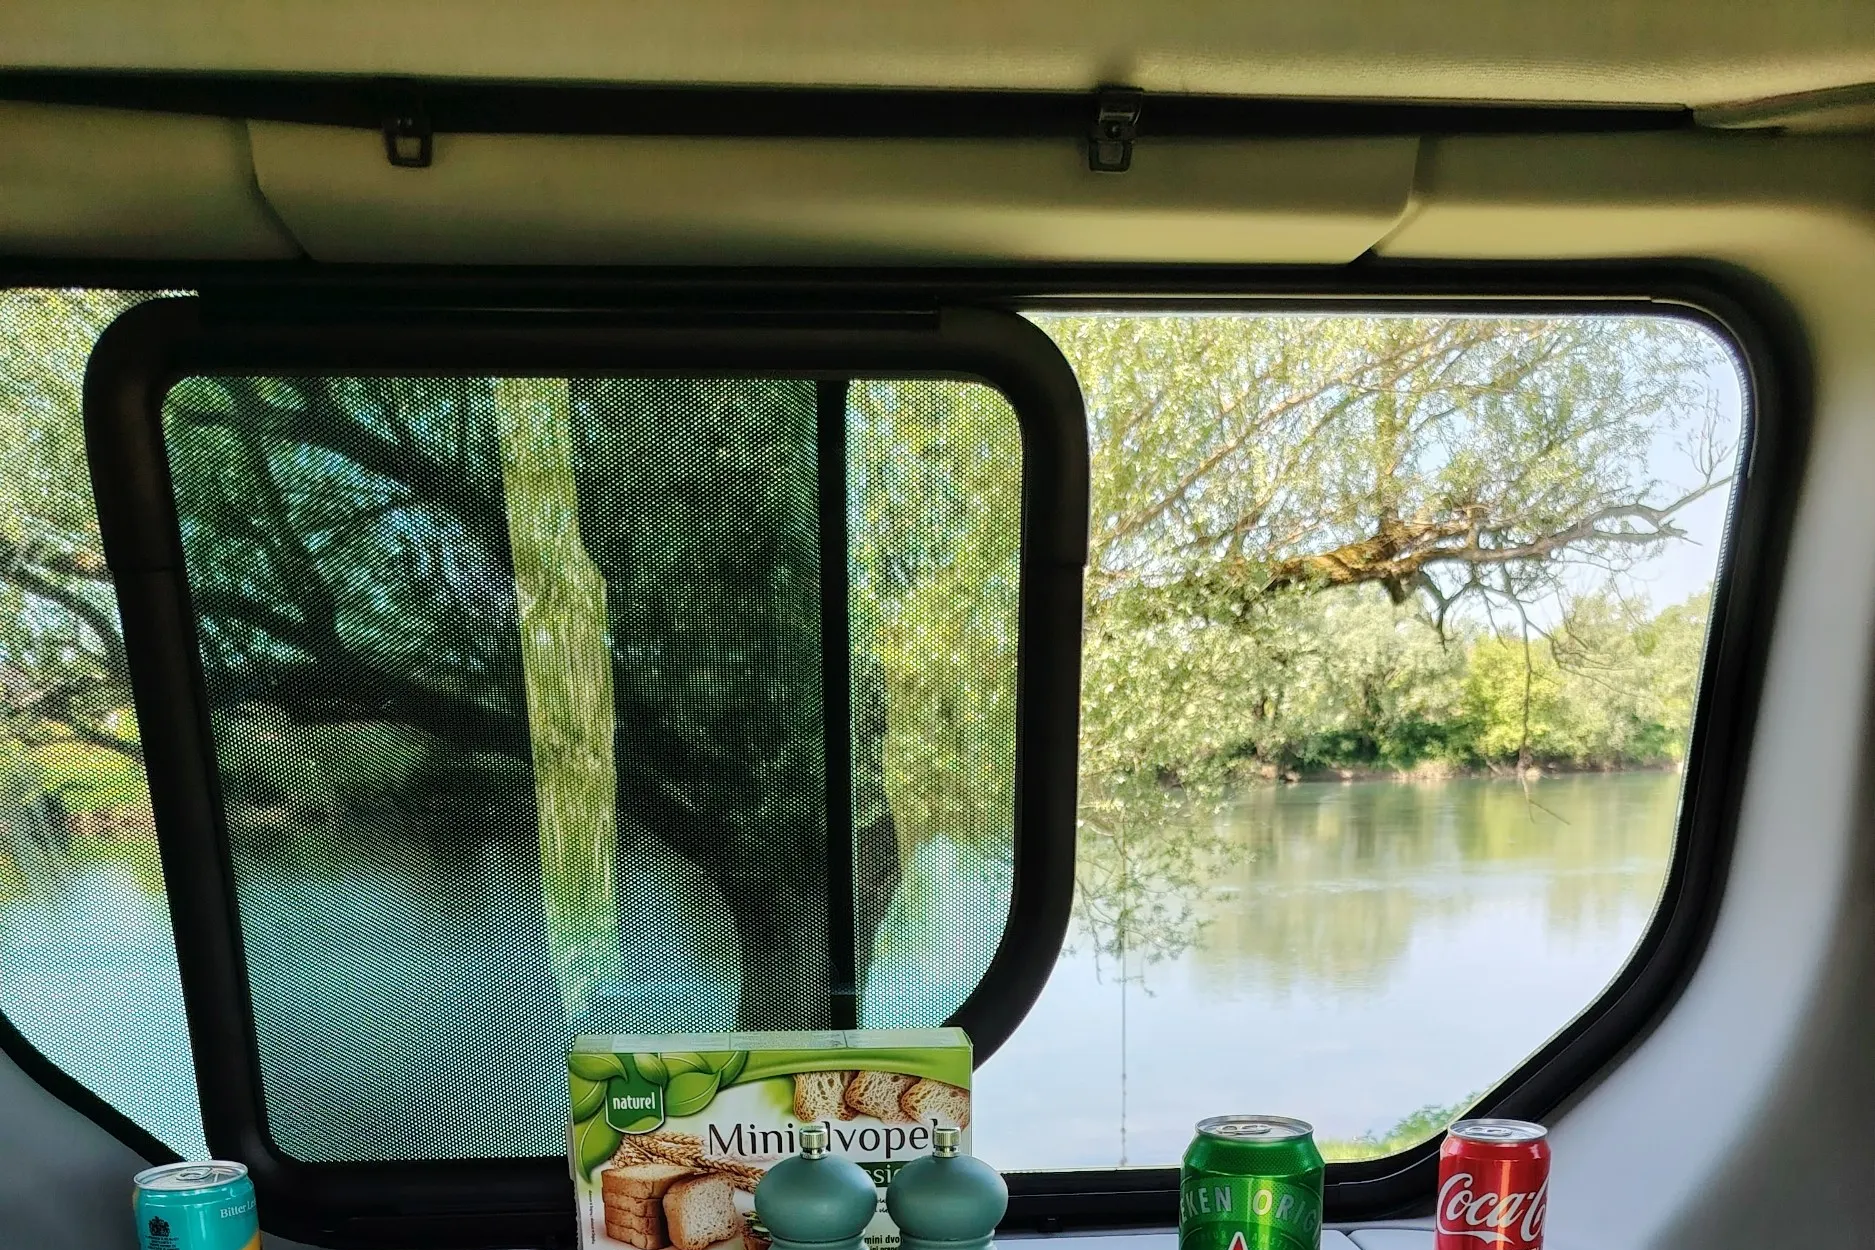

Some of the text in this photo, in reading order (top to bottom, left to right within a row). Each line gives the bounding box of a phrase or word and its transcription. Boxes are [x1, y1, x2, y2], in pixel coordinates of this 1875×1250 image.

[612, 1091, 656, 1110] naturel
[708, 1118, 938, 1159] Mini vope
[220, 1205, 247, 1219] Bitter
[885, 1235, 902, 1244] dvo
